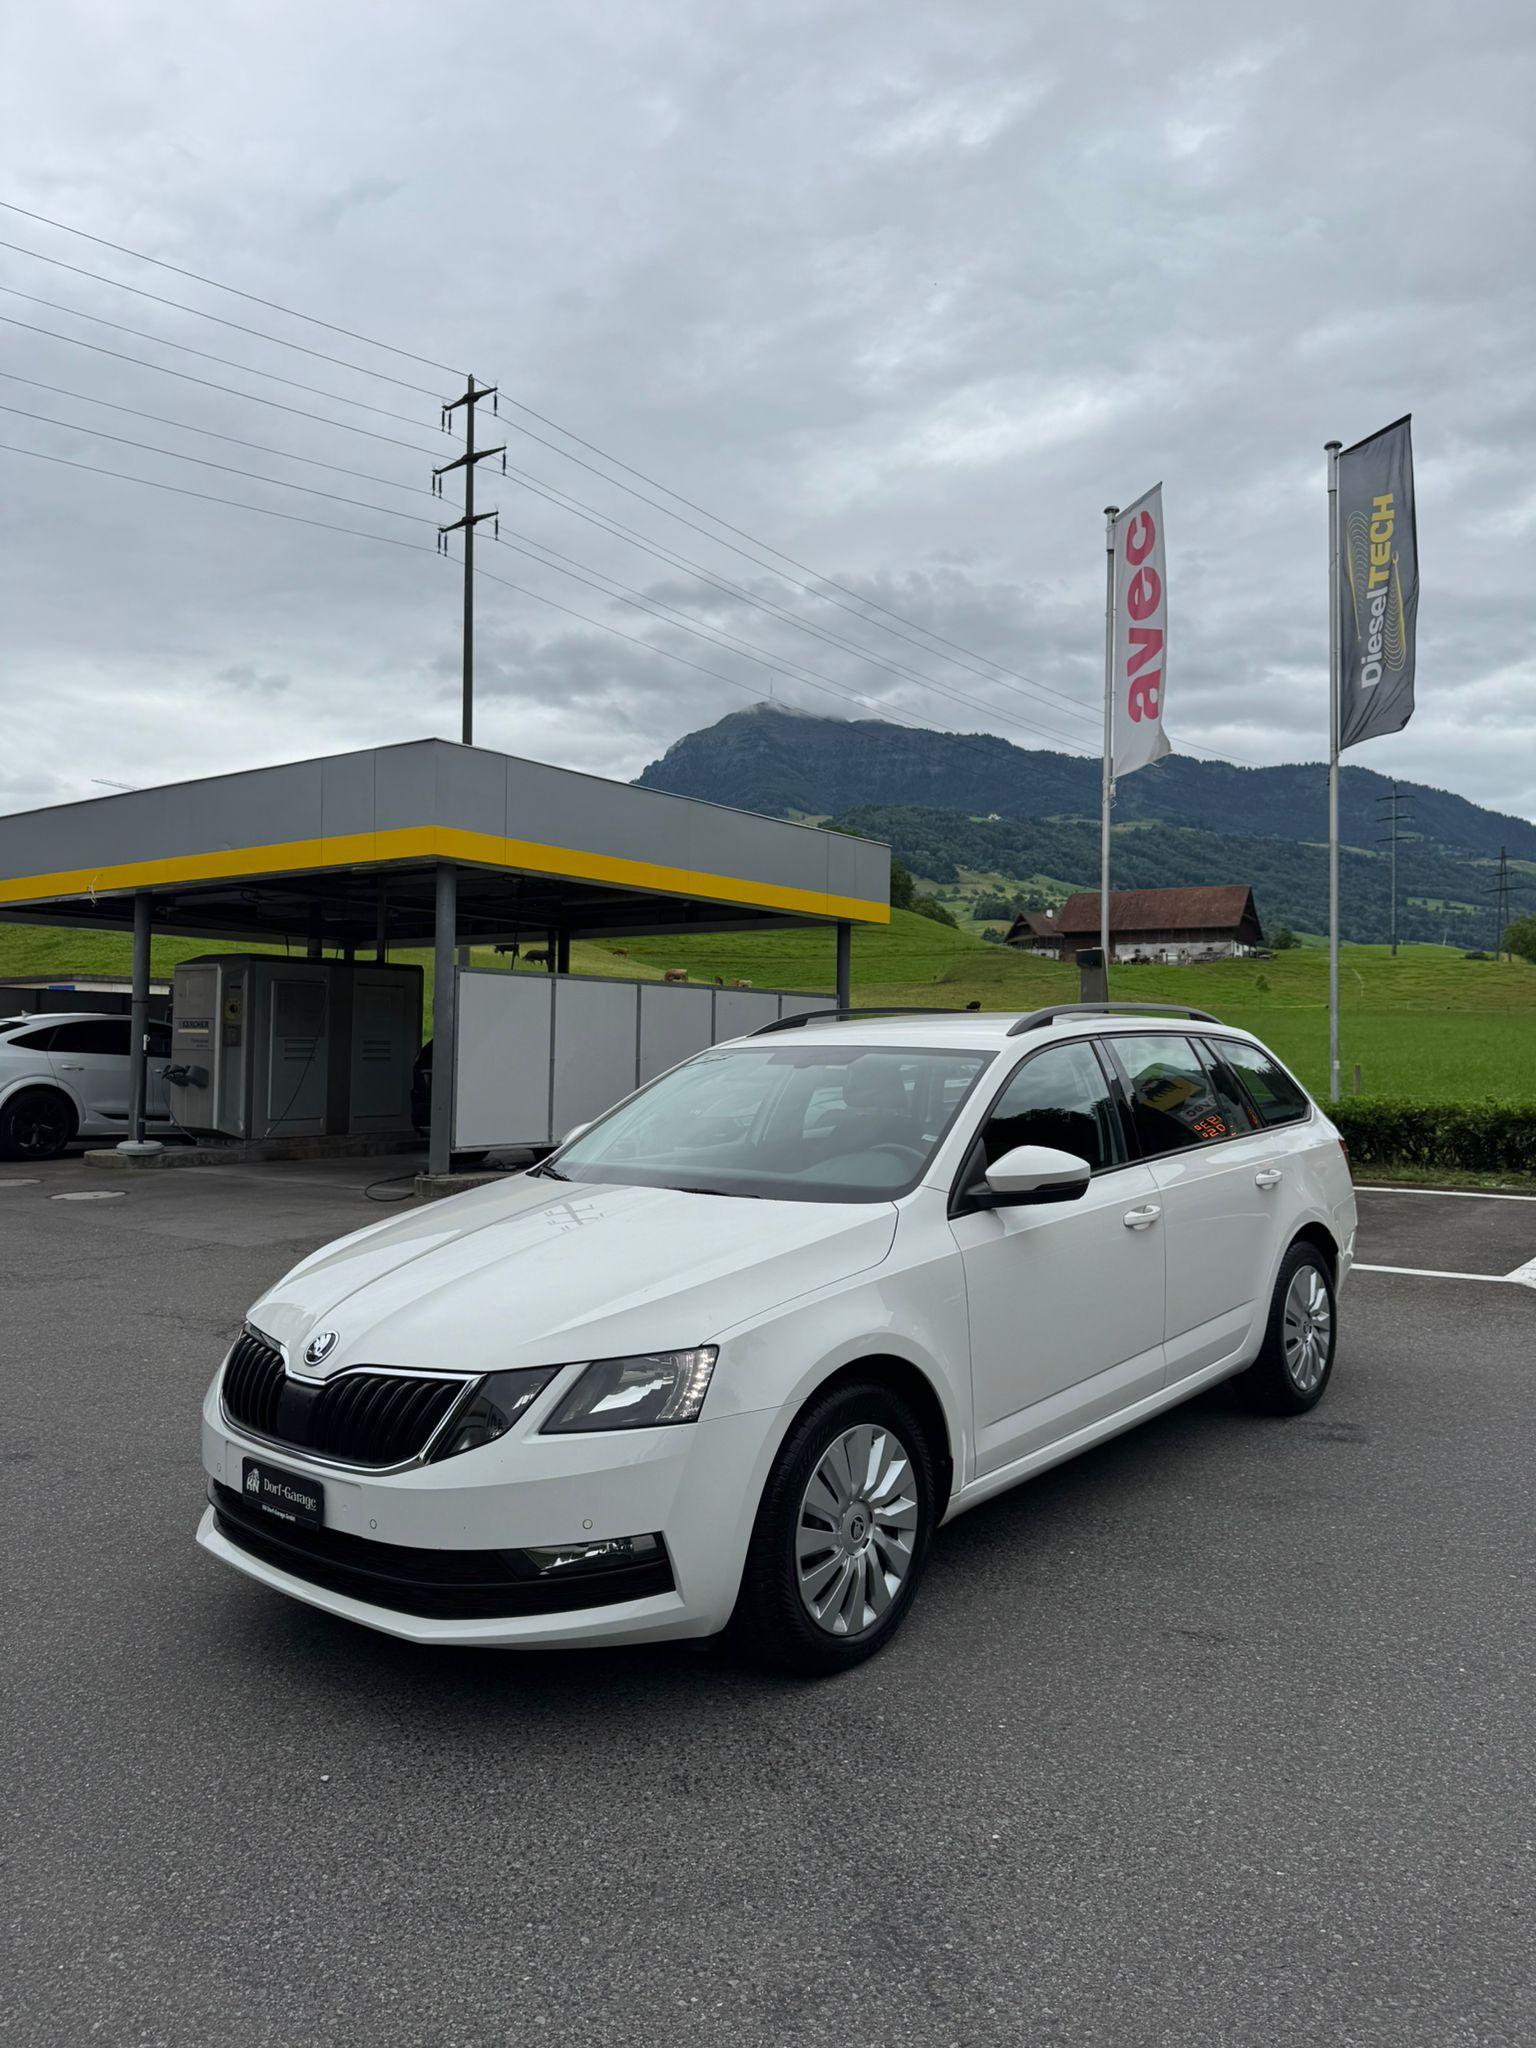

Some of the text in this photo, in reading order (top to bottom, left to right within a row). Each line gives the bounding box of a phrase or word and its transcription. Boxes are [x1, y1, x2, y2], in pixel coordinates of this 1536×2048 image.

[1126, 510, 1163, 723] avec
[1361, 493, 1395, 689] DieselTECH
[264, 1478, 317, 1510] Dorf-Garage
